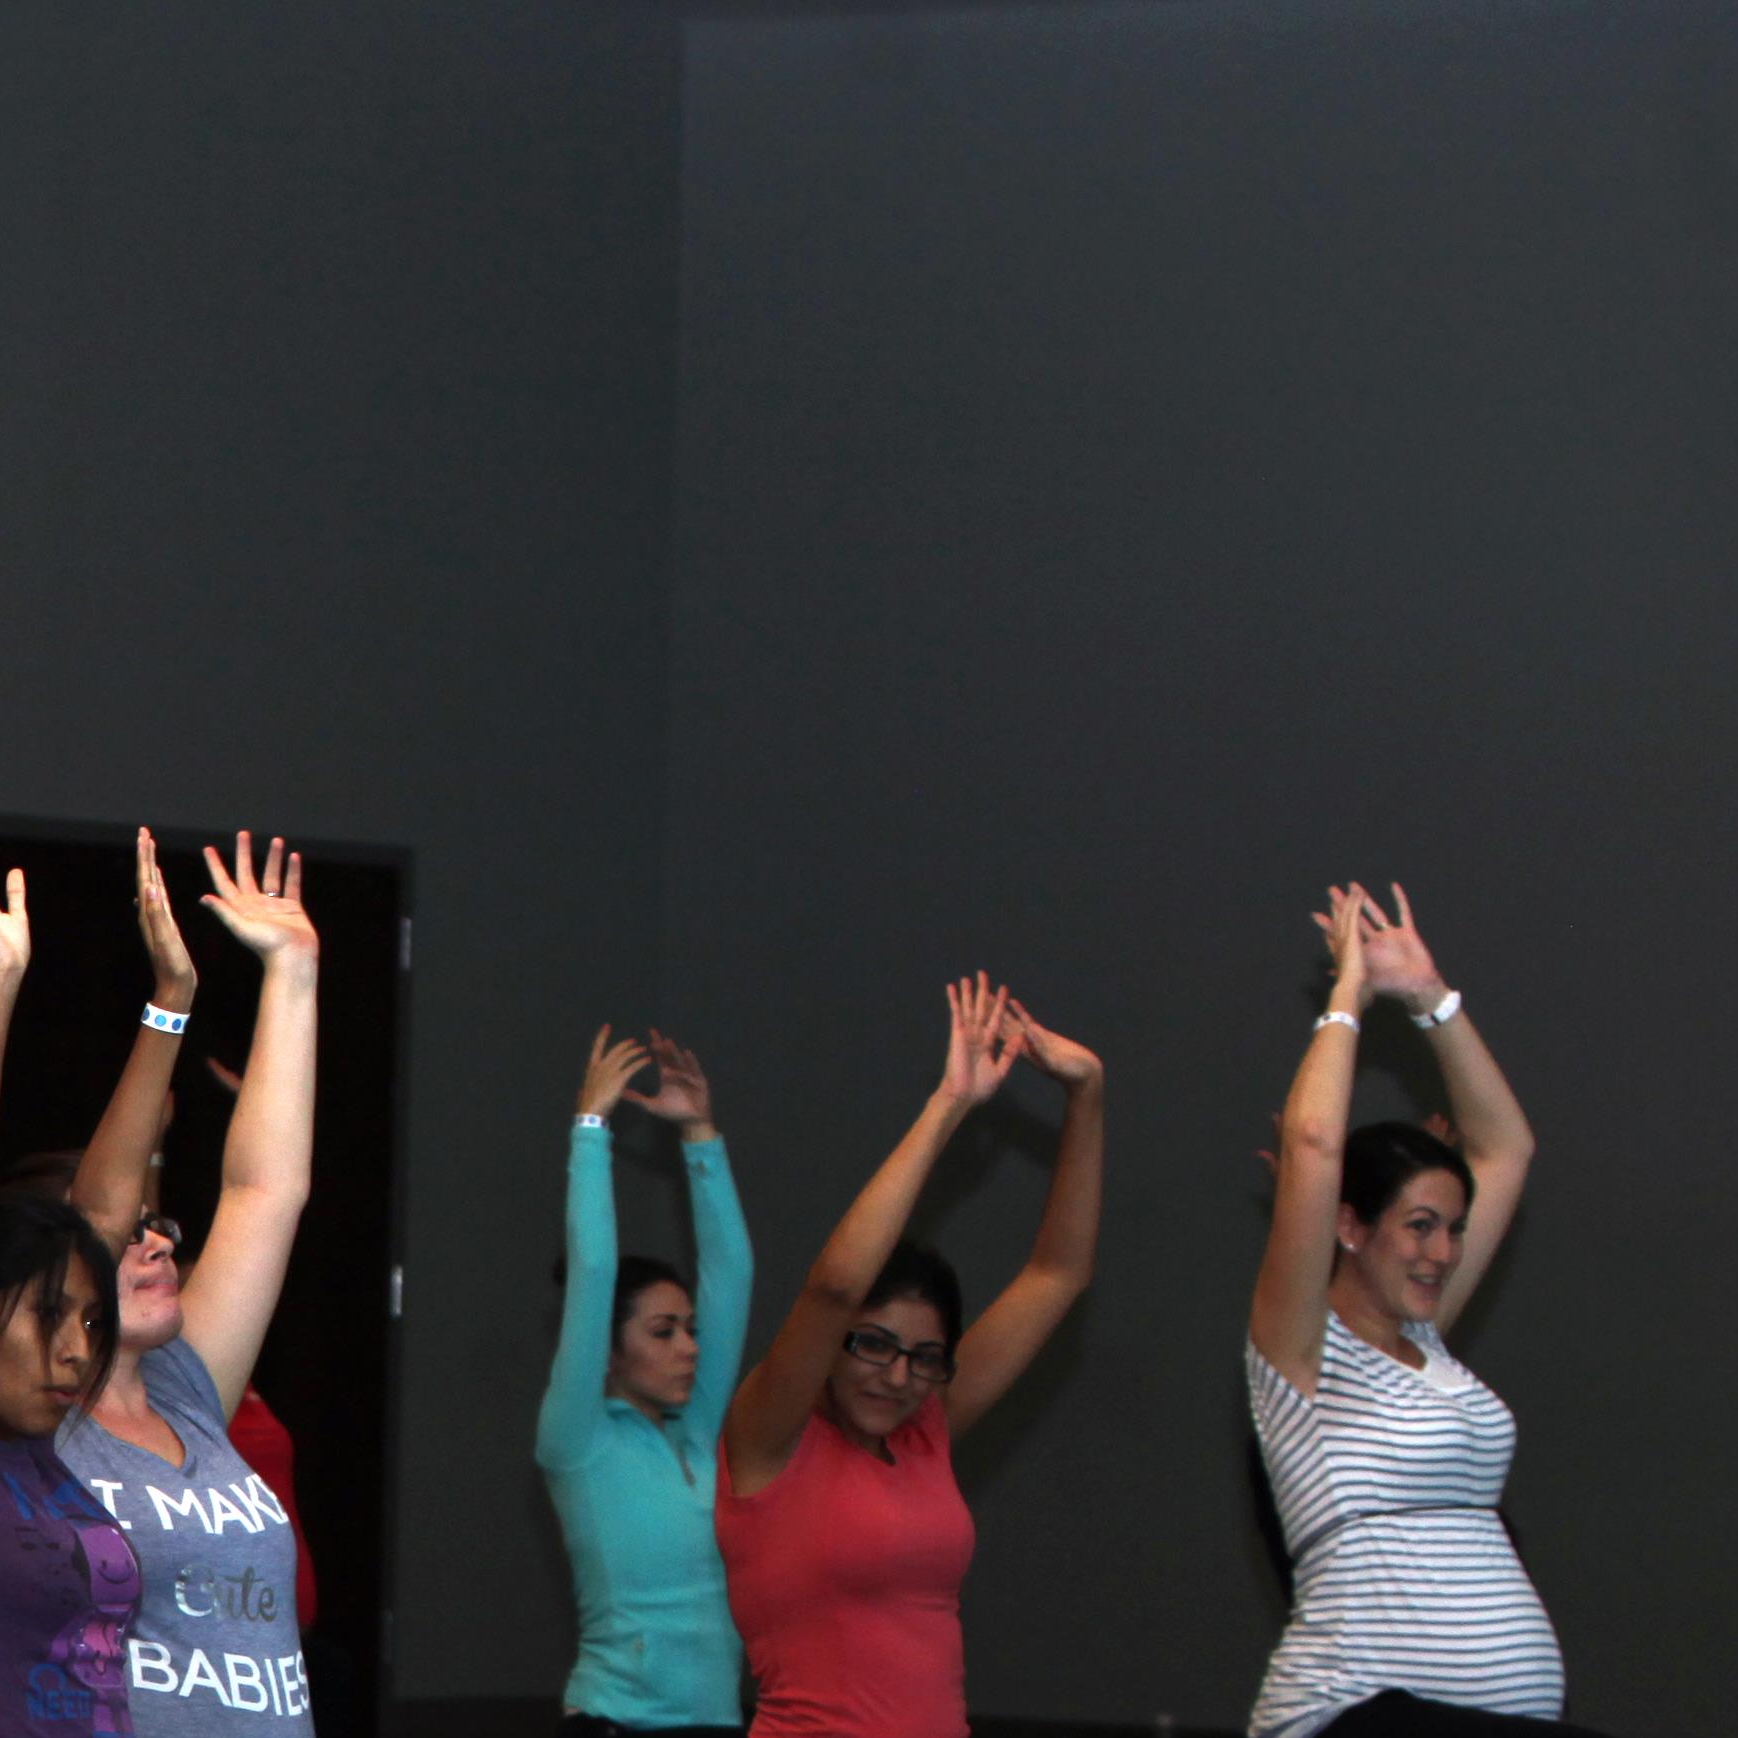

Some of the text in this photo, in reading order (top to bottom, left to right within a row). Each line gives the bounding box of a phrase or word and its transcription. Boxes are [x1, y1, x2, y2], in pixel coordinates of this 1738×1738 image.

[90, 1479, 132, 1530] I
[174, 1563, 278, 1623] Cute
[127, 1638, 311, 1717] BABIES
